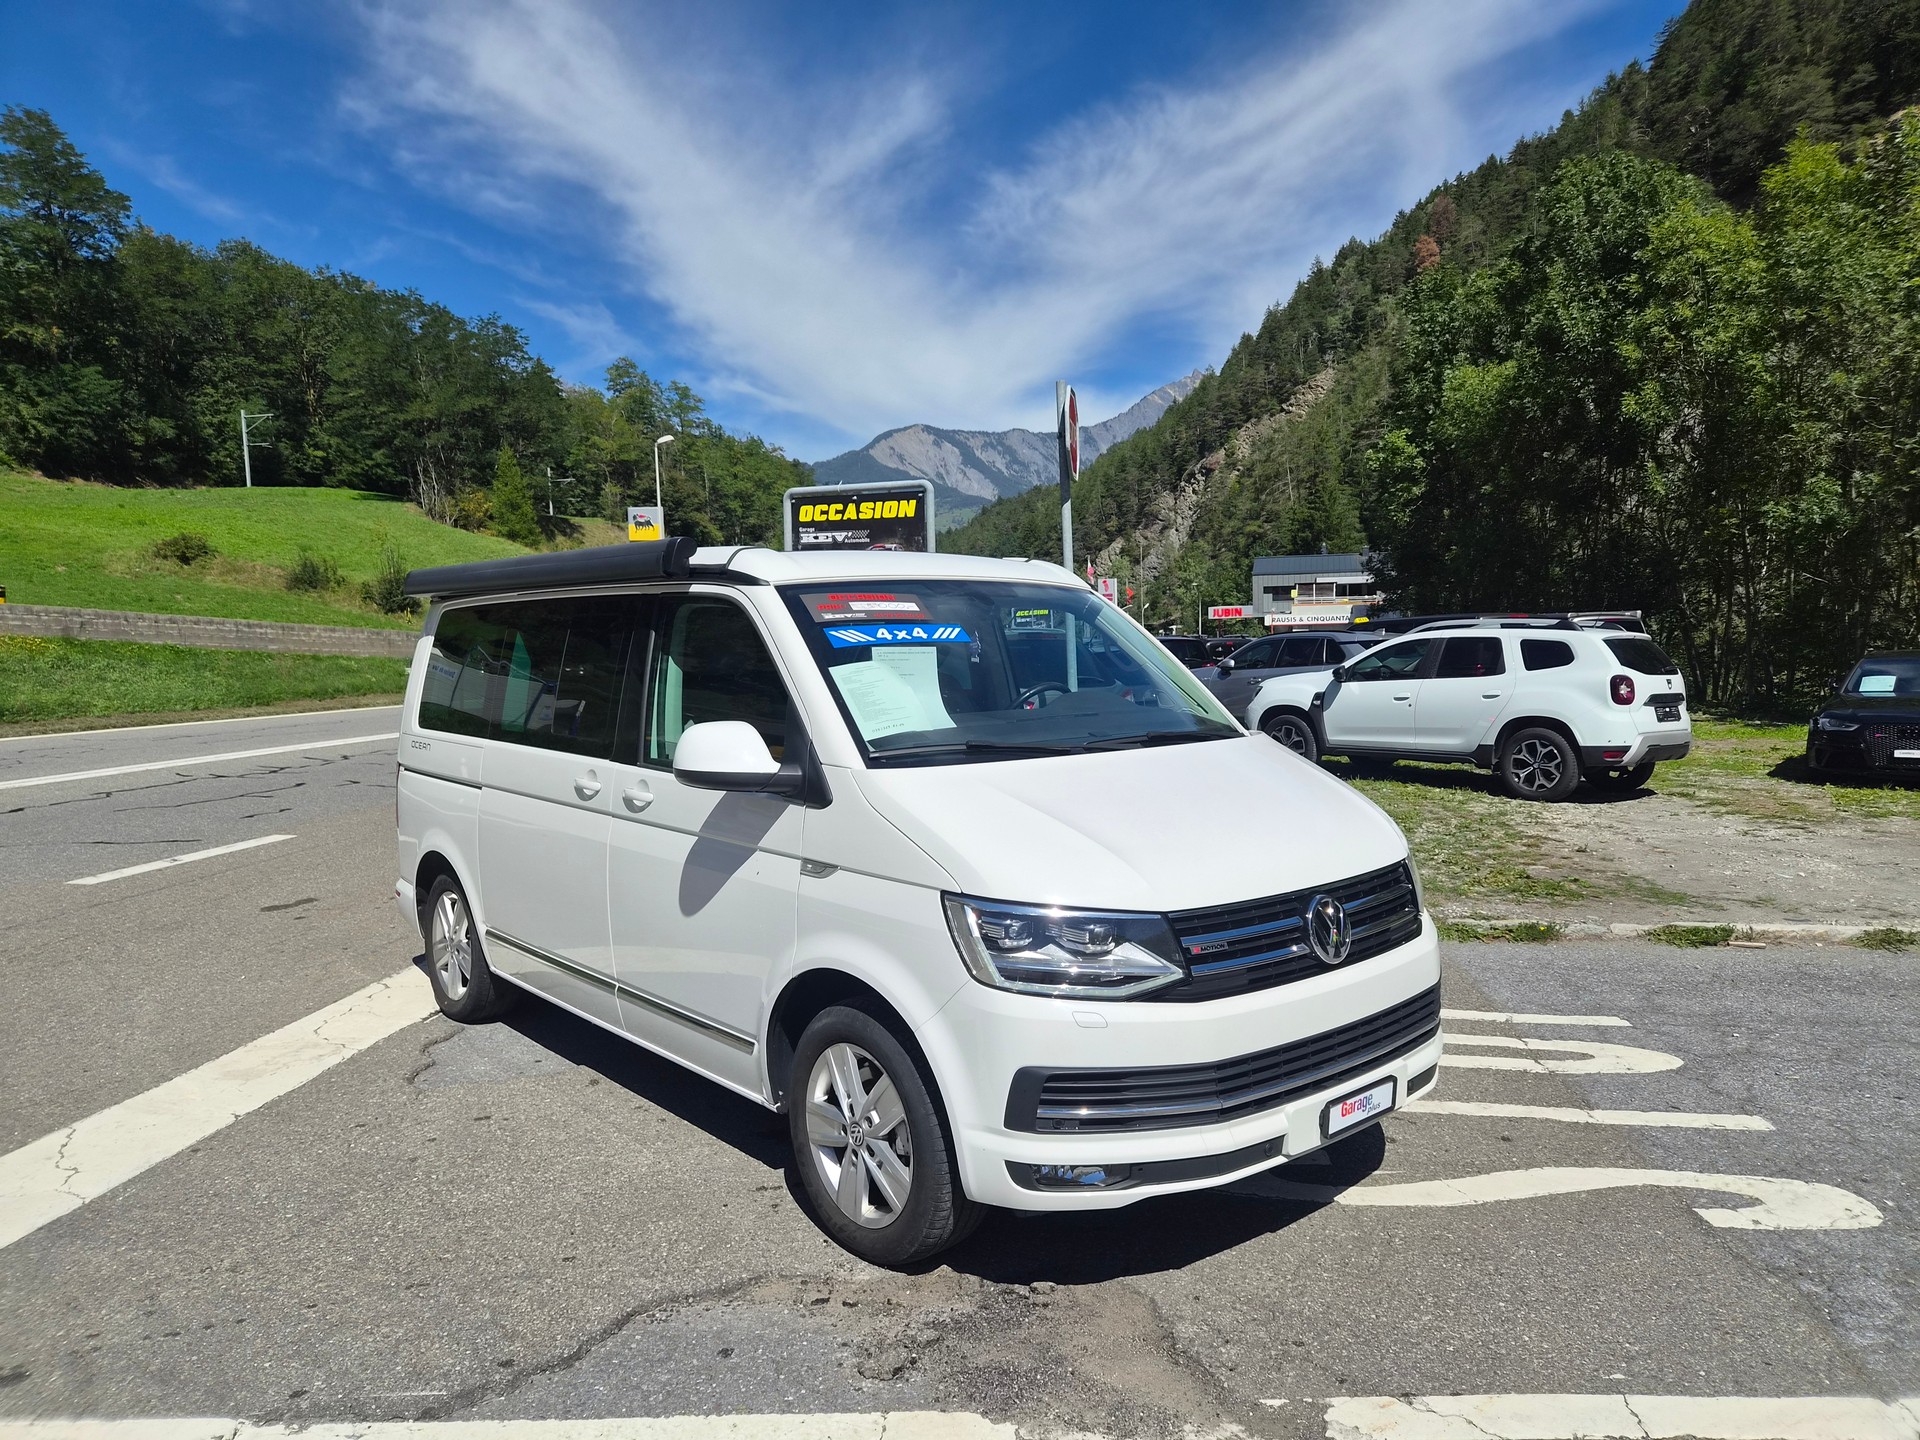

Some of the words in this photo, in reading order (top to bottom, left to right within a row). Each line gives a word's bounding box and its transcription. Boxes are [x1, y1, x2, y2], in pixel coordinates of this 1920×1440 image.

[799, 500, 917, 522] OCCASION
[1213, 607, 1243, 618] JUBIN
[876, 627, 928, 641] 4x4
[411, 740, 431, 752] OCEAN
[1193, 942, 1225, 953] MOTION
[1341, 1093, 1373, 1118] Garage
[1367, 1101, 1381, 1116] plus
